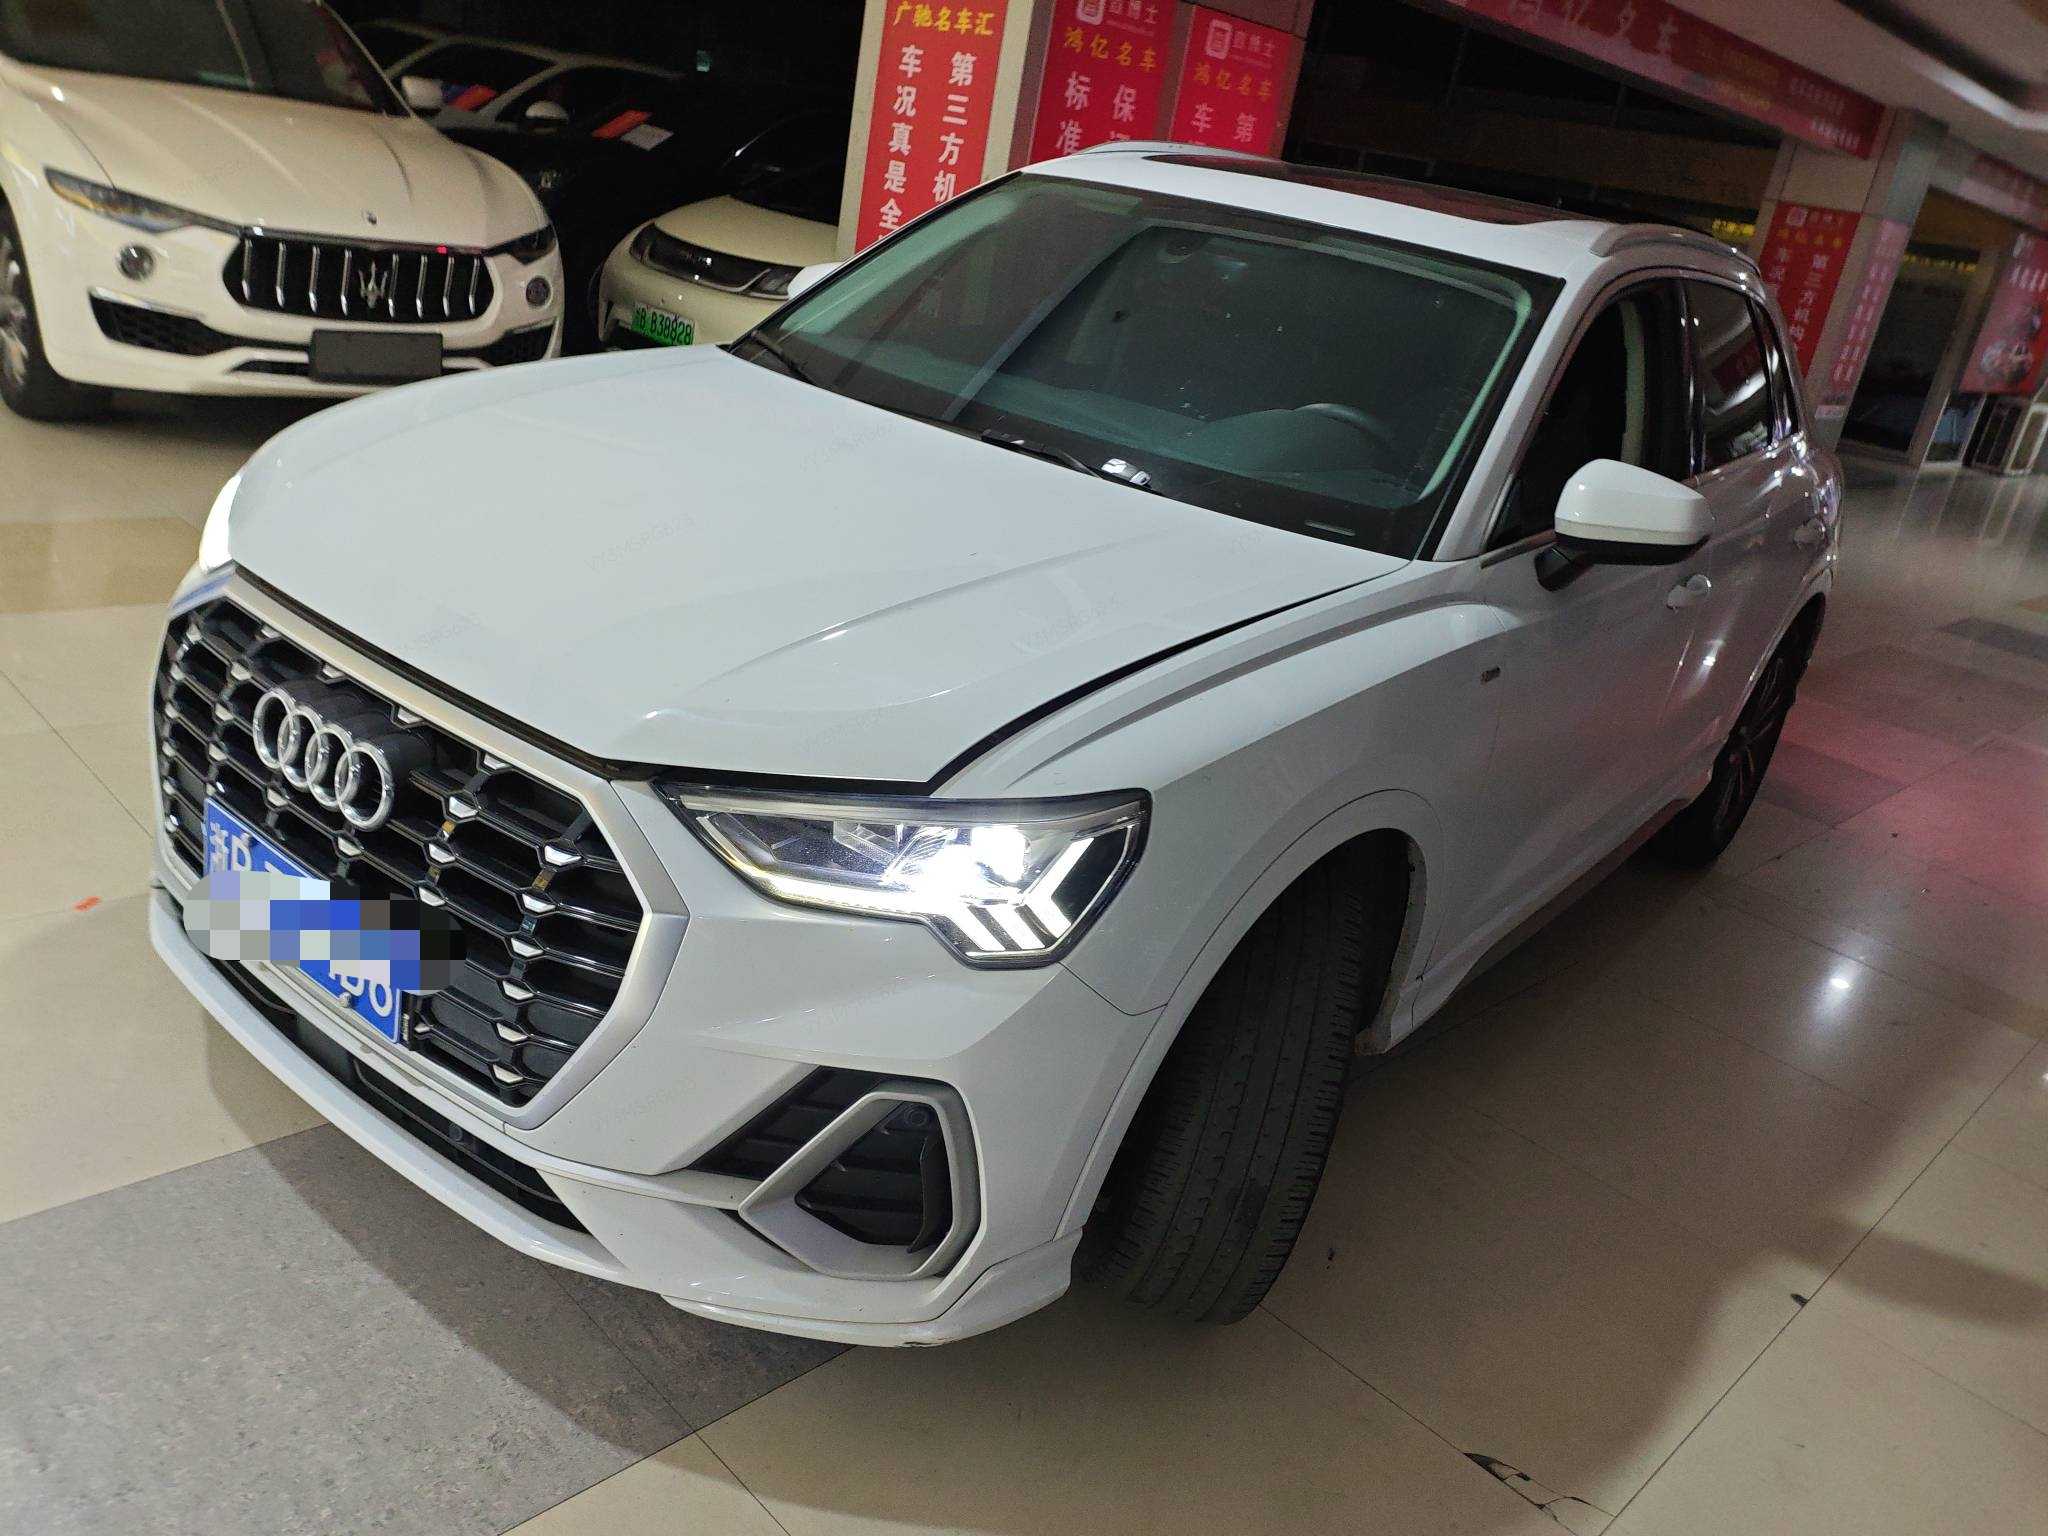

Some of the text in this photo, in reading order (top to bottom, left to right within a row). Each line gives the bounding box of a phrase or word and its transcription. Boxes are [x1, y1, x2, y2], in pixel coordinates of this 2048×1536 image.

[893, 0, 995, 36] 广驰名车汇
[878, 44, 924, 242] 车况真是全
[932, 51, 977, 203] 第三方机
[1109, 84, 1137, 141] 保
